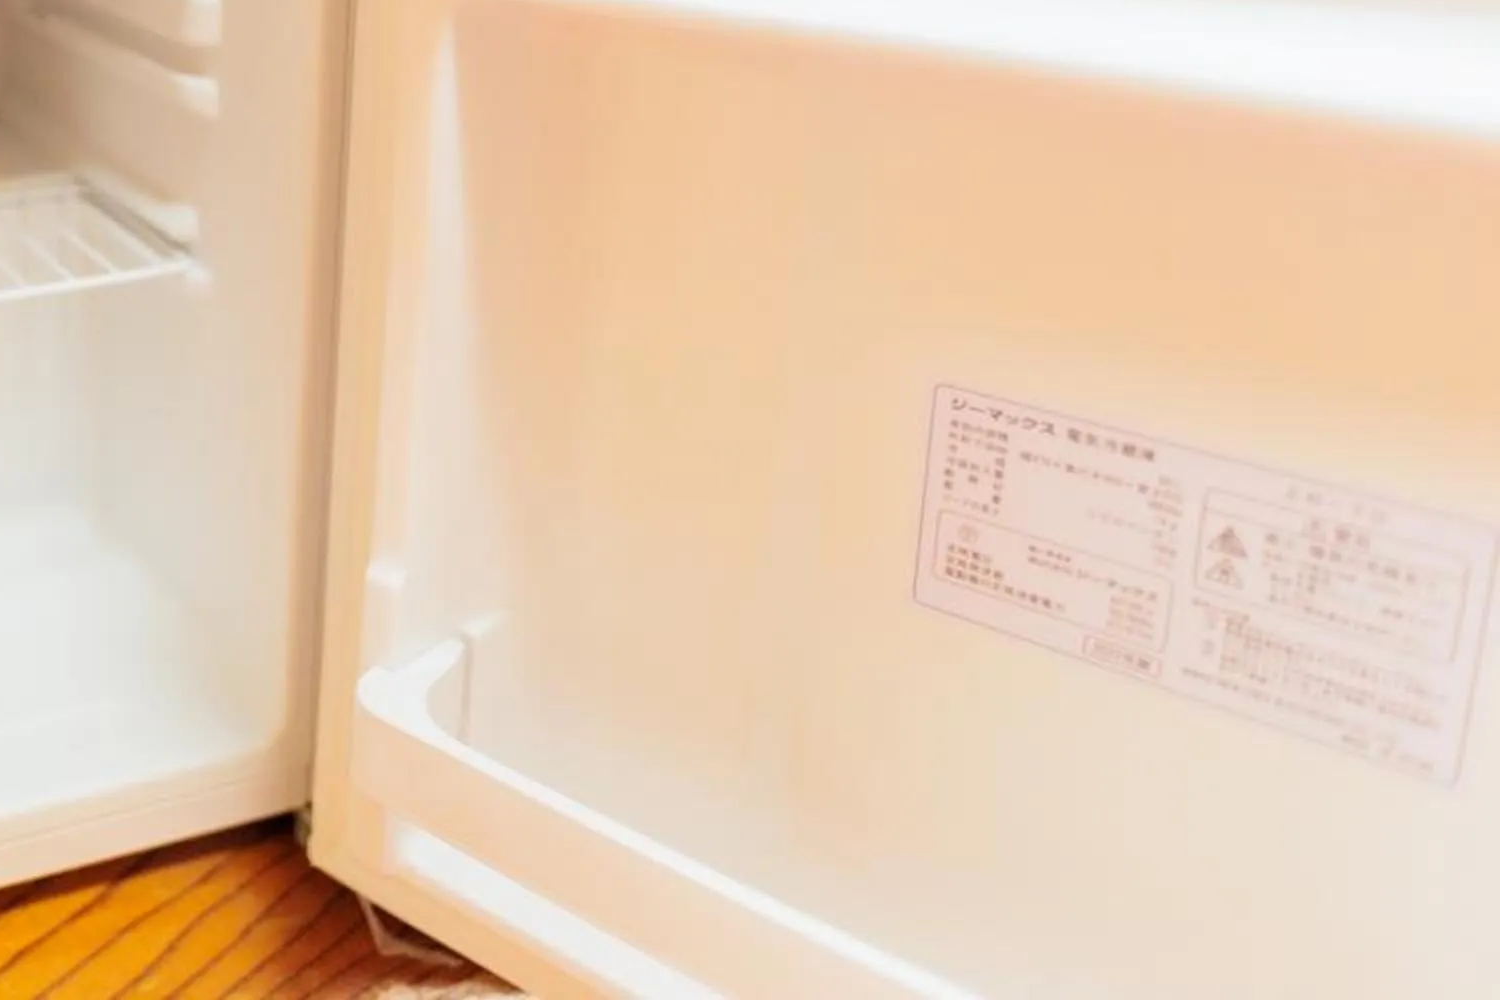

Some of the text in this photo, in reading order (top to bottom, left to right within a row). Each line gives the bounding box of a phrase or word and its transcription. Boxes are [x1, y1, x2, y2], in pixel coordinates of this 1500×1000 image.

[951, 397, 1055, 436] ジーマックス
